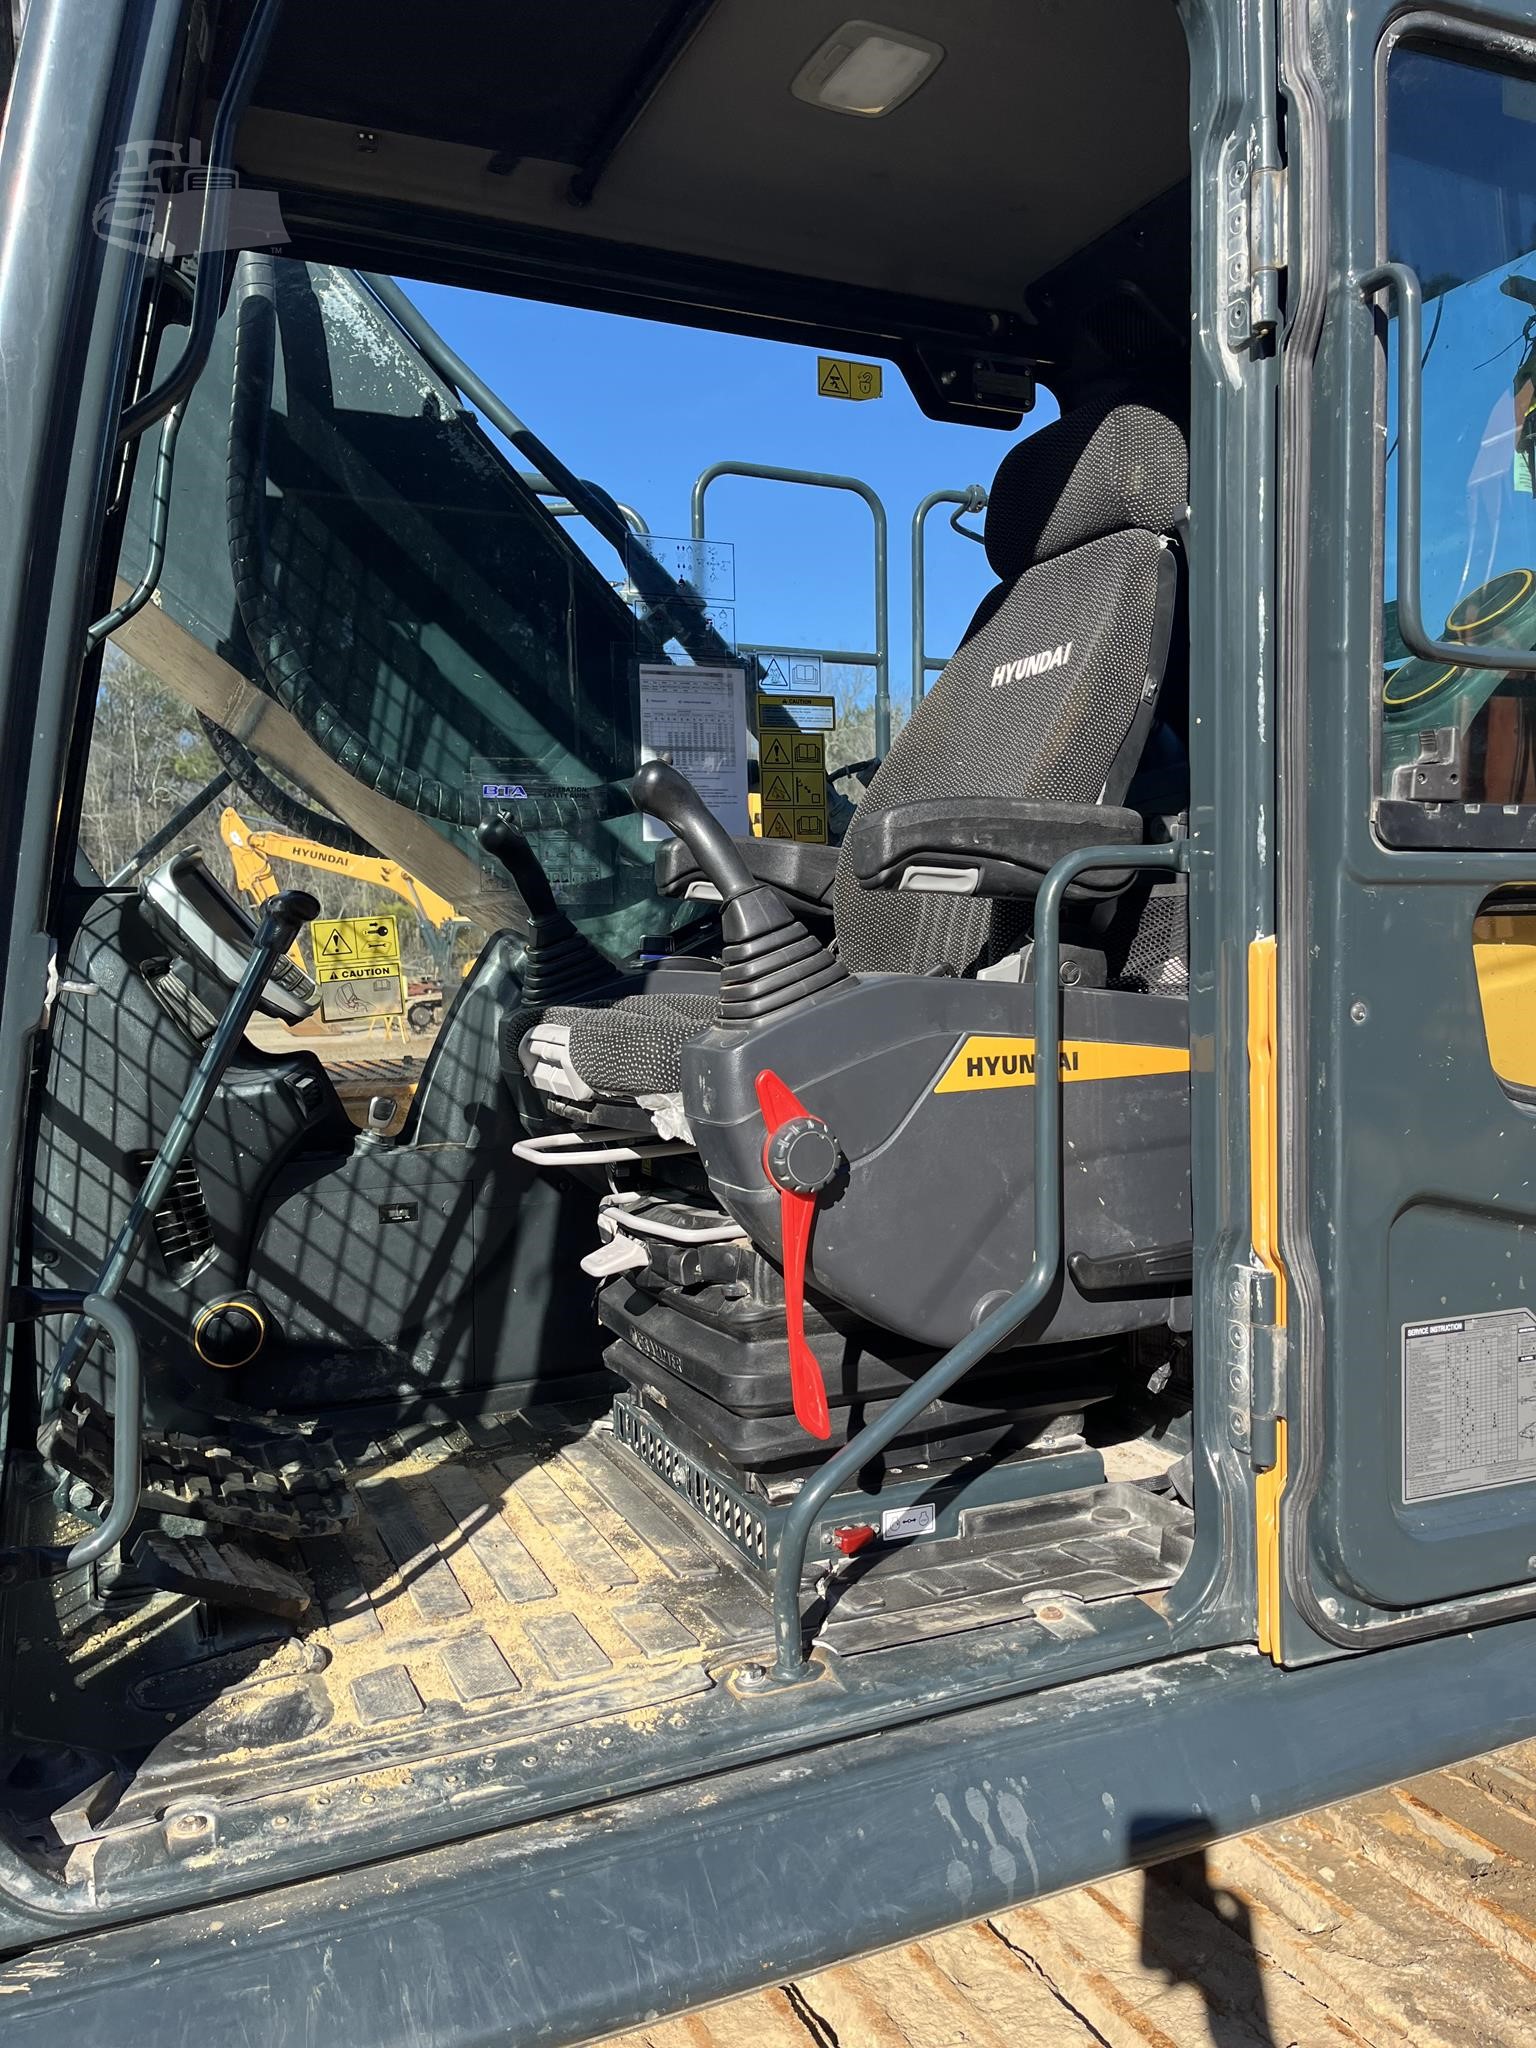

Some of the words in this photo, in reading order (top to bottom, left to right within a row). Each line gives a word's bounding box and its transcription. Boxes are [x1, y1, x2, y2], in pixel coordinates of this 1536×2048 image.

[990, 641, 1072, 688] HYUNDAI
[483, 785, 527, 798] BTA
[292, 847, 349, 866] HYUNDAI
[341, 968, 390, 979] CAUTION
[967, 1052, 1078, 1077] HYUNAI
[1407, 1326, 1429, 1337] SERVICE
[1429, 1322, 1463, 1334] INSTRUCTION
